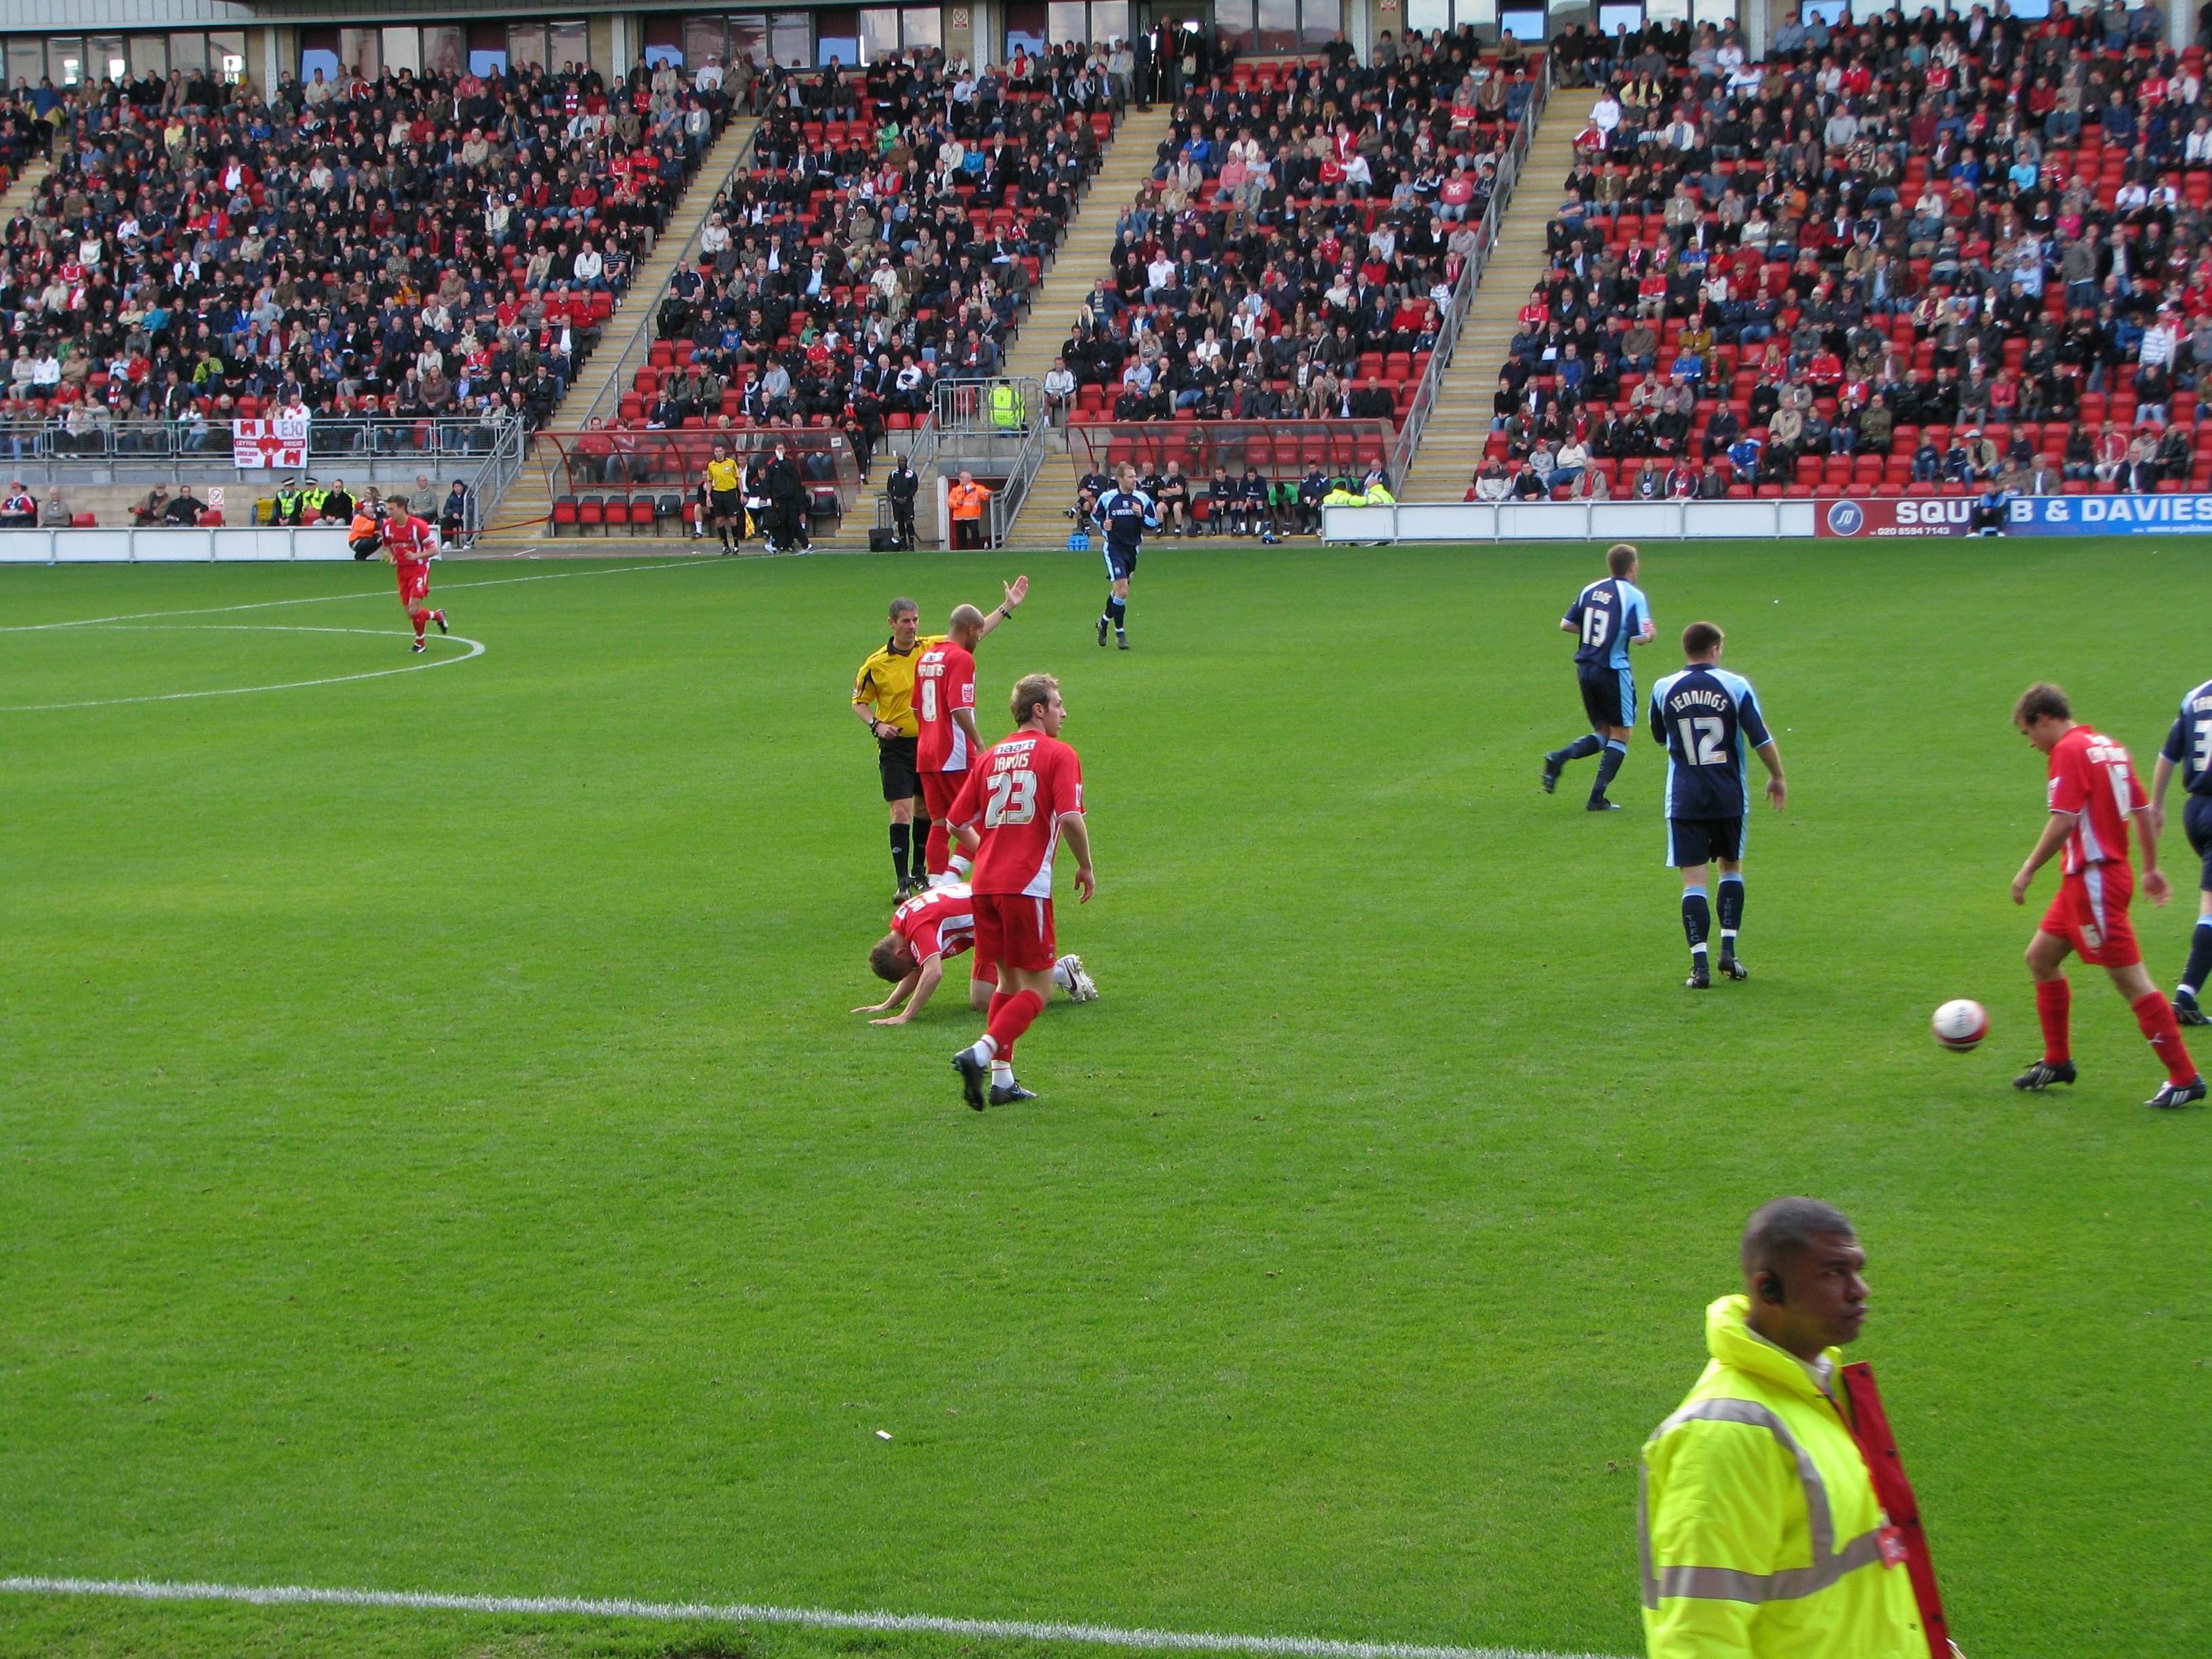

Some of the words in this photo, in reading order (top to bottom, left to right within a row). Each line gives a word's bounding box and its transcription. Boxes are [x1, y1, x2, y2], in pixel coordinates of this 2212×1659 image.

[2045, 499, 2070, 523] &
[2081, 498, 2212, 522] DAVIES
[1877, 527, 1896, 535] 020
[1925, 527, 1950, 535] 7143
[1582, 607, 1610, 647] 13
[1670, 690, 1728, 712] JENNINGS
[1677, 716, 1727, 765] 12
[985, 770, 1037, 829] 23
